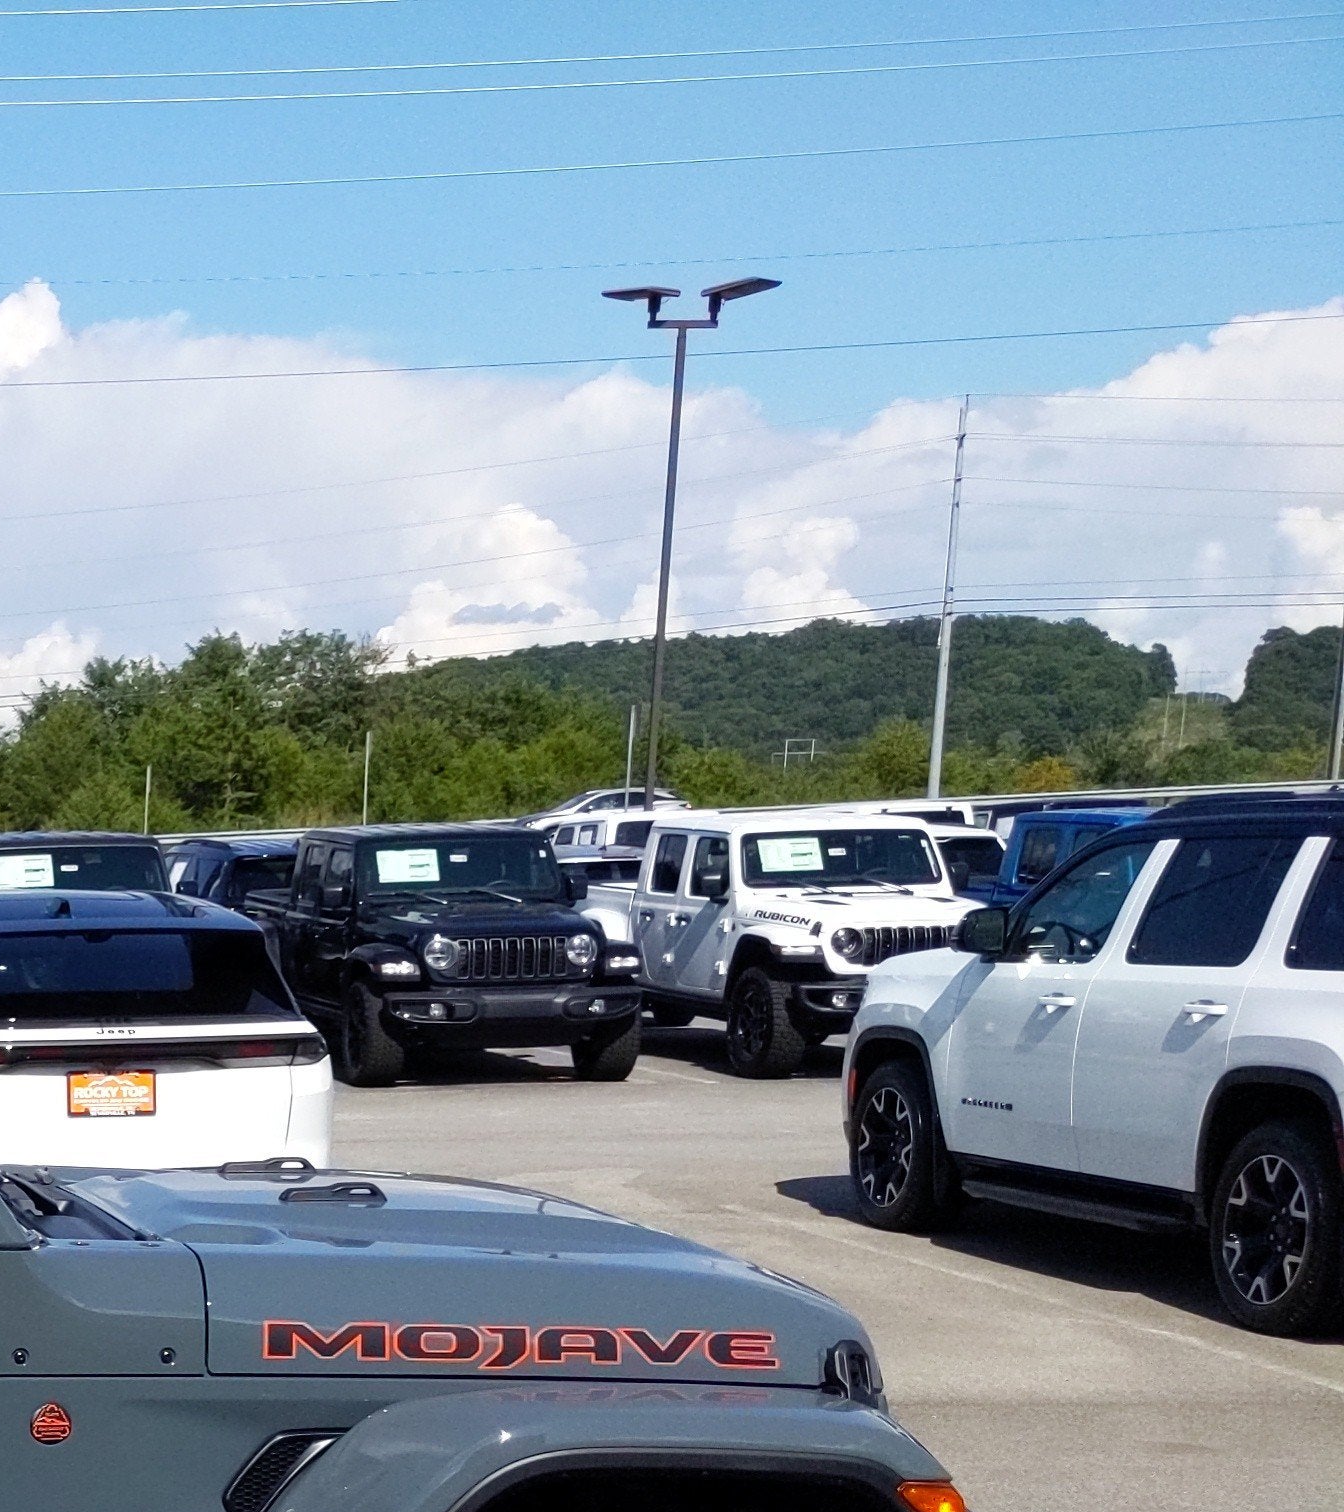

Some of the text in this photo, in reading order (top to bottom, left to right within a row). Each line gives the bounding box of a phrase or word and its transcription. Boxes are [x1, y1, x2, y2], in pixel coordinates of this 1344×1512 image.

[754, 910, 811, 925] RUBICON
[73, 1085, 150, 1099] ROCKY TOP
[262, 1319, 780, 1370] MOJAVE
